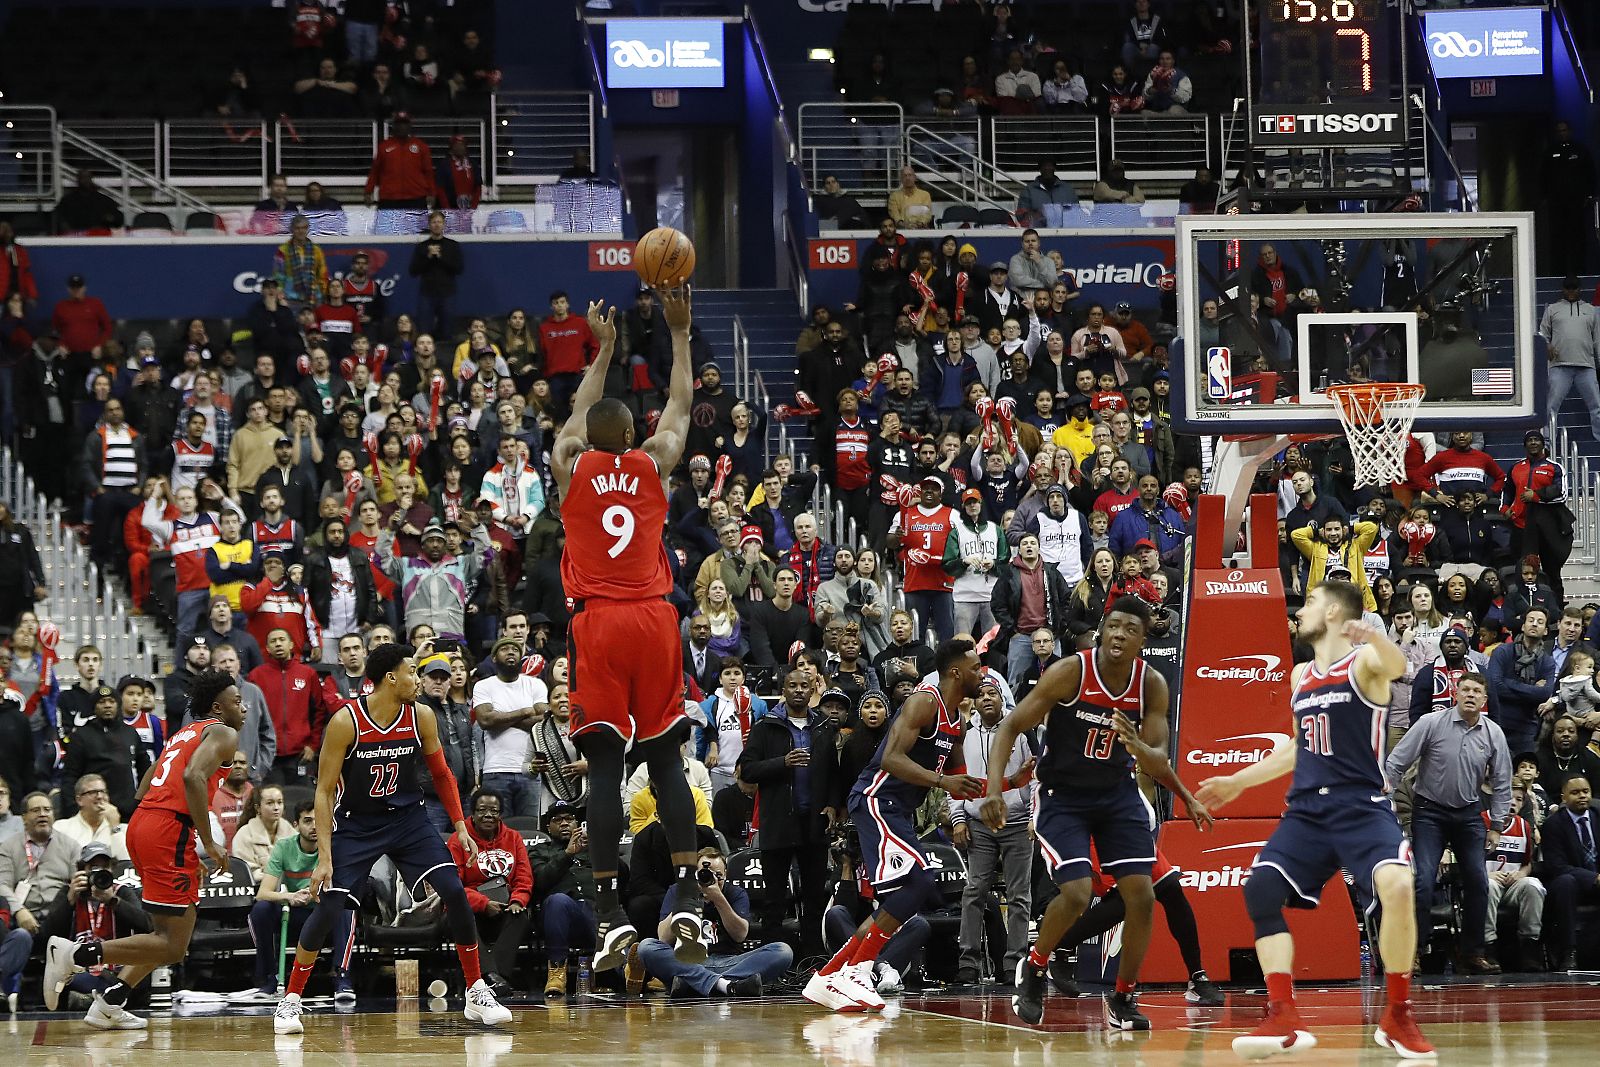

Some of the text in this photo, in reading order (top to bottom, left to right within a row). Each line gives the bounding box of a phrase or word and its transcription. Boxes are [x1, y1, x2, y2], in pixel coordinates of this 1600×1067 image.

[1335, 28, 1371, 91] 7
[1472, 81, 1494, 95] EXIT
[1296, 113, 1399, 133] TISSOT
[596, 247, 632, 266] 106
[816, 246, 850, 264] 105
[1196, 411, 1230, 420] SPALDING
[1449, 470, 1482, 480] wizards
[591, 473, 640, 496] IBAKA
[602, 505, 635, 559] 9
[911, 522, 944, 532] district
[922, 532, 931, 549] 3
[1045, 532, 1077, 543] district
[748, 587, 764, 602] 10
[1205, 580, 1270, 596] SPALDING
[1300, 713, 1334, 756] 31
[356, 745, 415, 759] washington
[1083, 728, 1117, 760] 13
[151, 749, 181, 787] 3
[369, 762, 399, 798] 22
[197, 886, 255, 898] ETLINX
